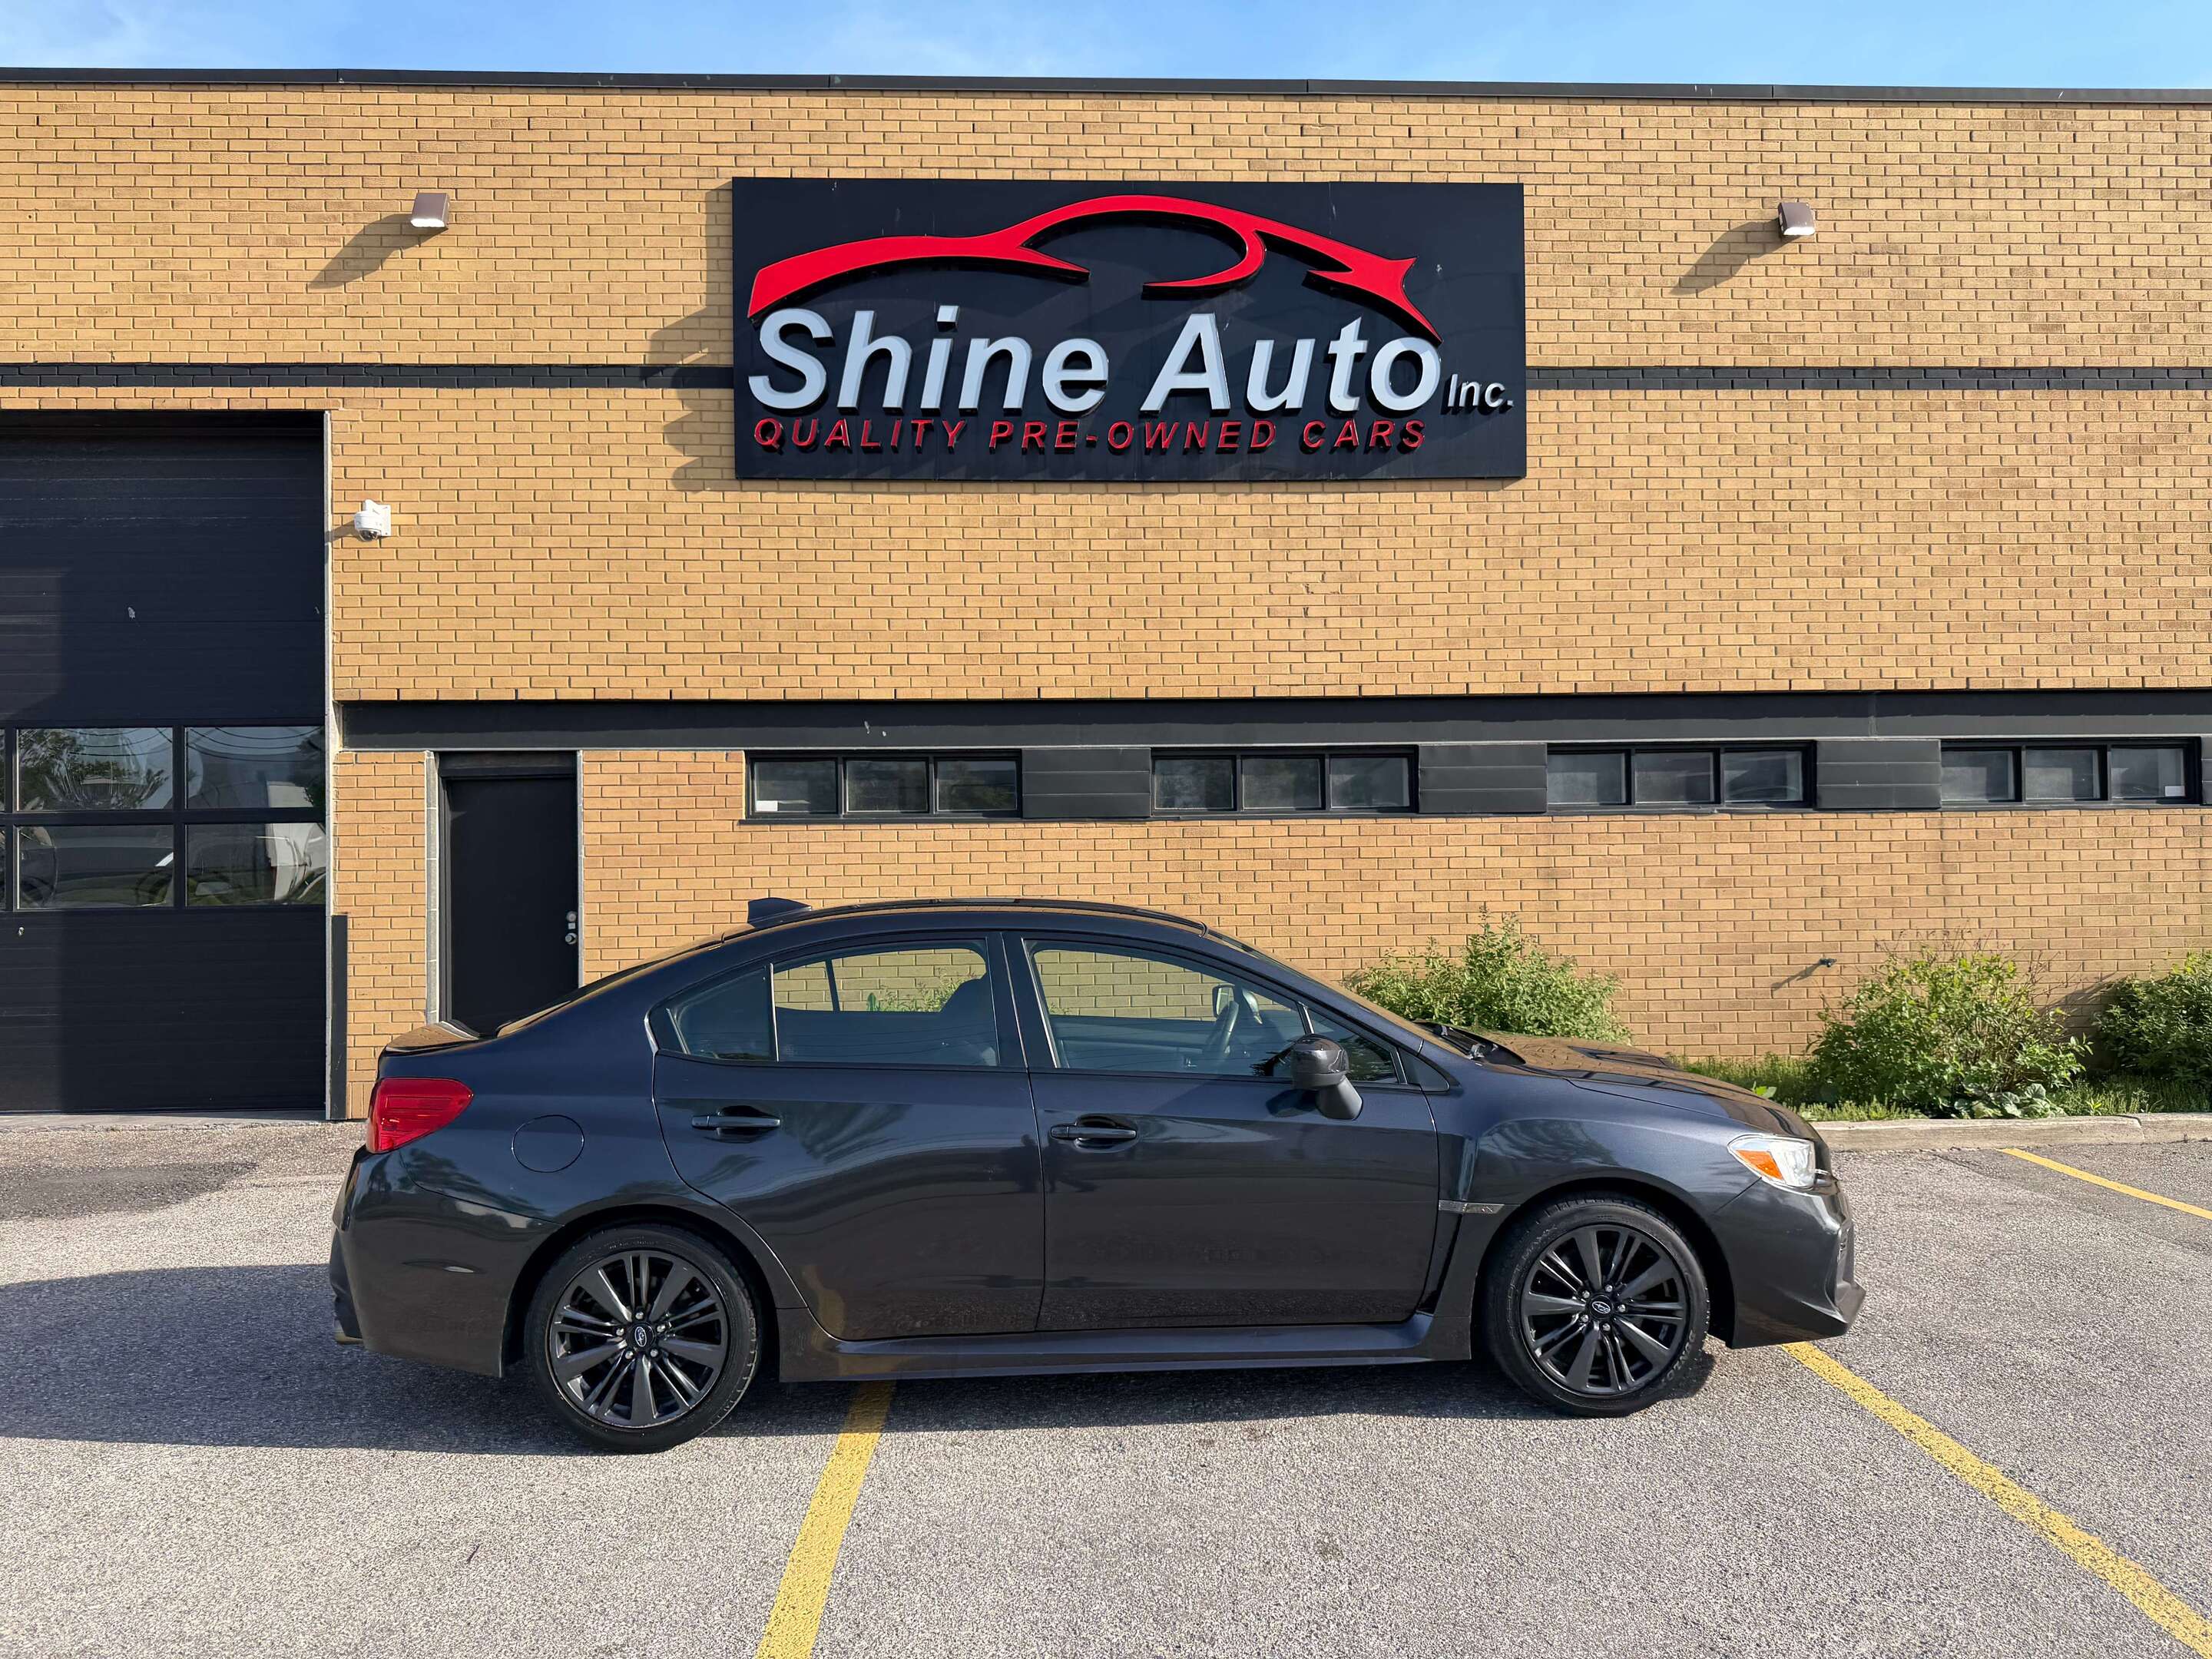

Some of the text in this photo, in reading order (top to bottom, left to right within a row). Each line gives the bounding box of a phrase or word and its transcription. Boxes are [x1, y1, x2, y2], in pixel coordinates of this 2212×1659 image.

[748, 305, 1515, 413] Shine Auto Inc.
[753, 418, 1426, 452] QUALITY PRE-OWNED CARS
